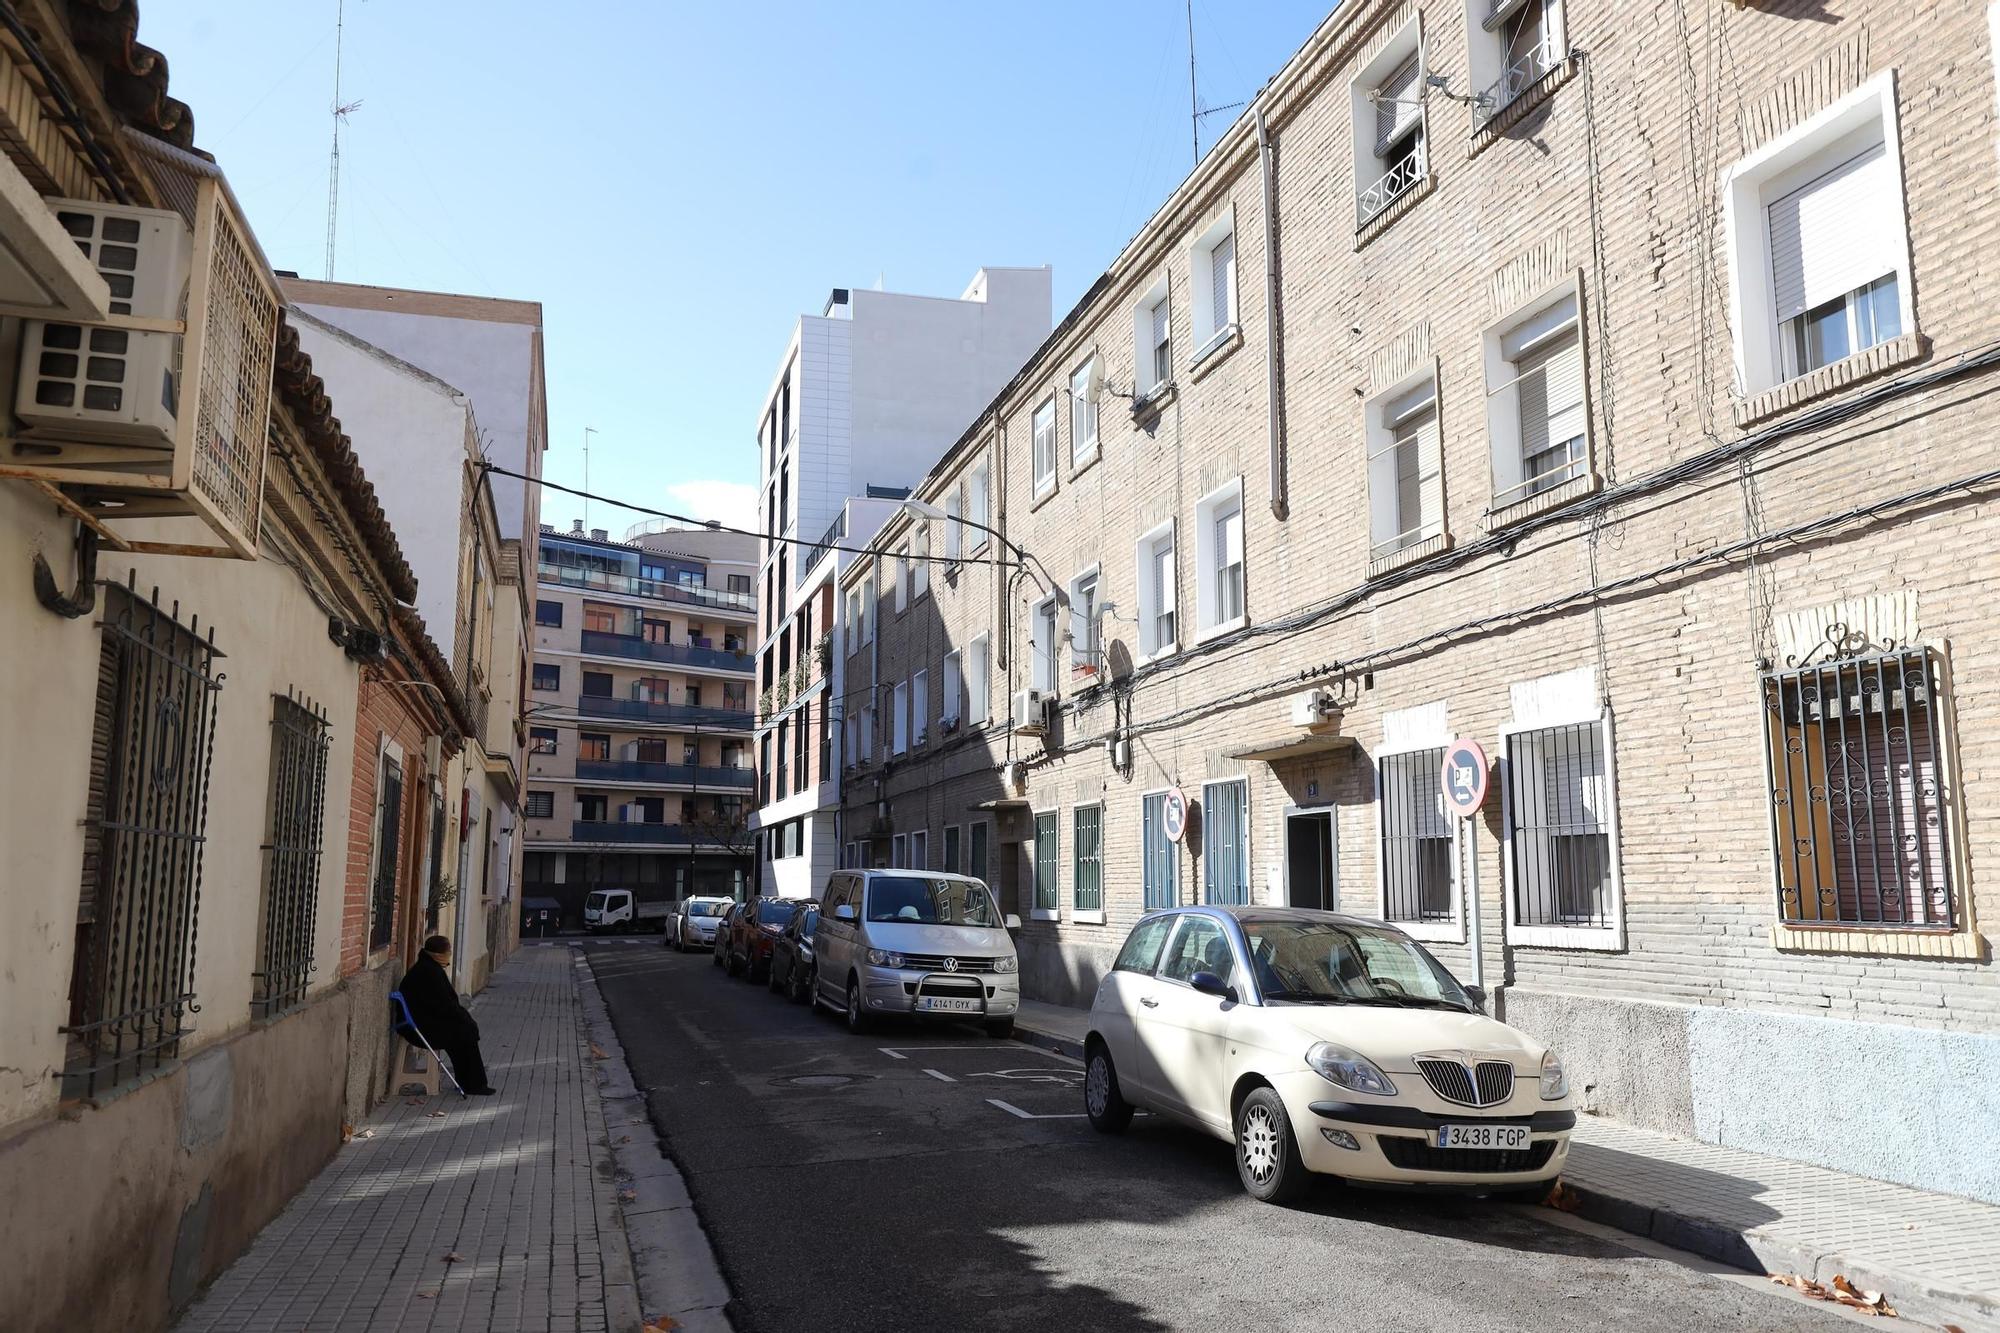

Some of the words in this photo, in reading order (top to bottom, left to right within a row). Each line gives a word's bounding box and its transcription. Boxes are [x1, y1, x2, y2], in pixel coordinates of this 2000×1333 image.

[933, 999, 952, 1009] 4141
[955, 1000, 970, 1009] GYX
[1451, 1128, 1491, 1146] 3438
[1496, 1128, 1526, 1146] FGP
